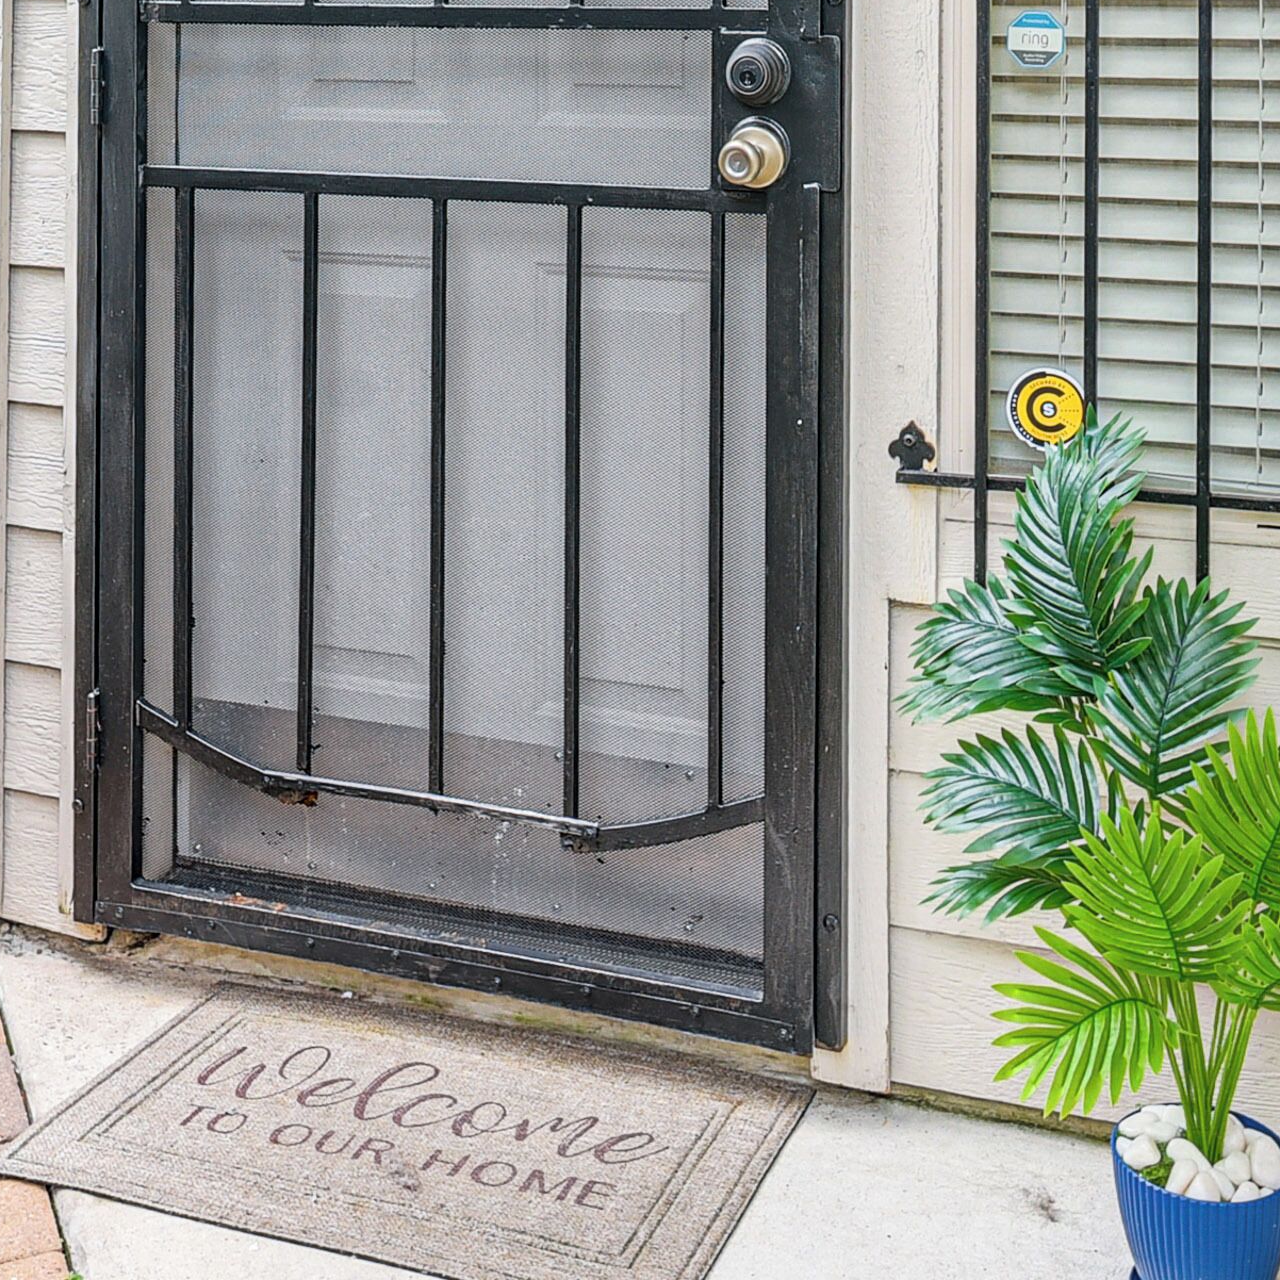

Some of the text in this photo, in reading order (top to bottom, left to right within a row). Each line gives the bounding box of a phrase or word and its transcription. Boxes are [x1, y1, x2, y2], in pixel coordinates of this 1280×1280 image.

[1021, 30, 1049, 48] ring
[179, 1104, 618, 1211] TO OUR HOME
[196, 1045, 670, 1165] Welcome
